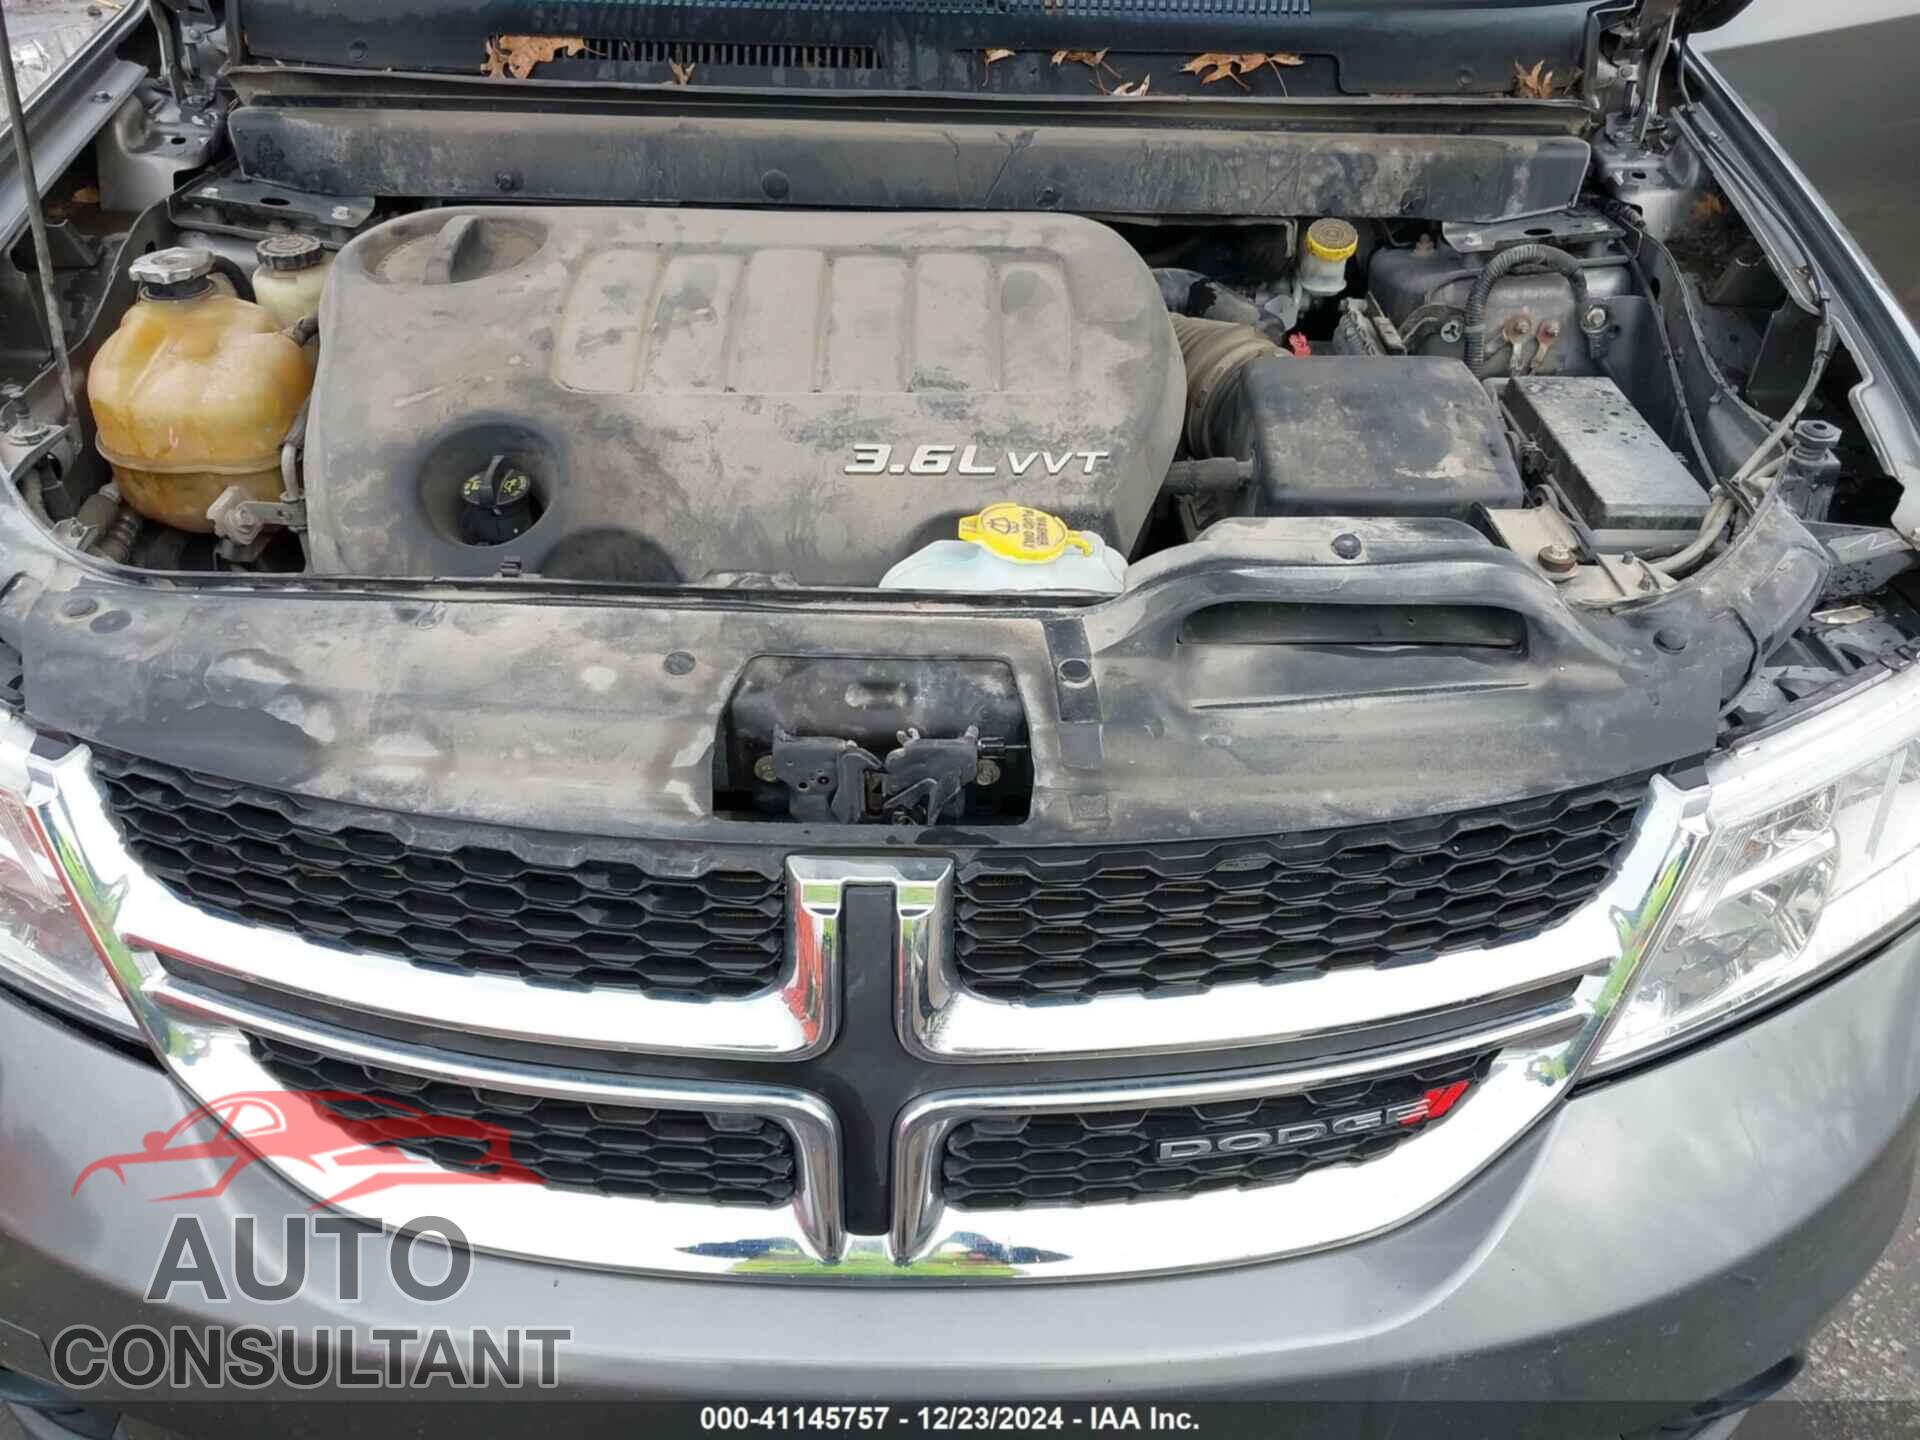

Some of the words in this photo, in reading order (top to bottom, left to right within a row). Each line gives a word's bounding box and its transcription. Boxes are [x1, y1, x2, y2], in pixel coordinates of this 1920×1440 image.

[844, 444, 997, 475] 3.6L
[1007, 451, 1110, 476] VVT
[1159, 1098, 1431, 1160] DODGE
